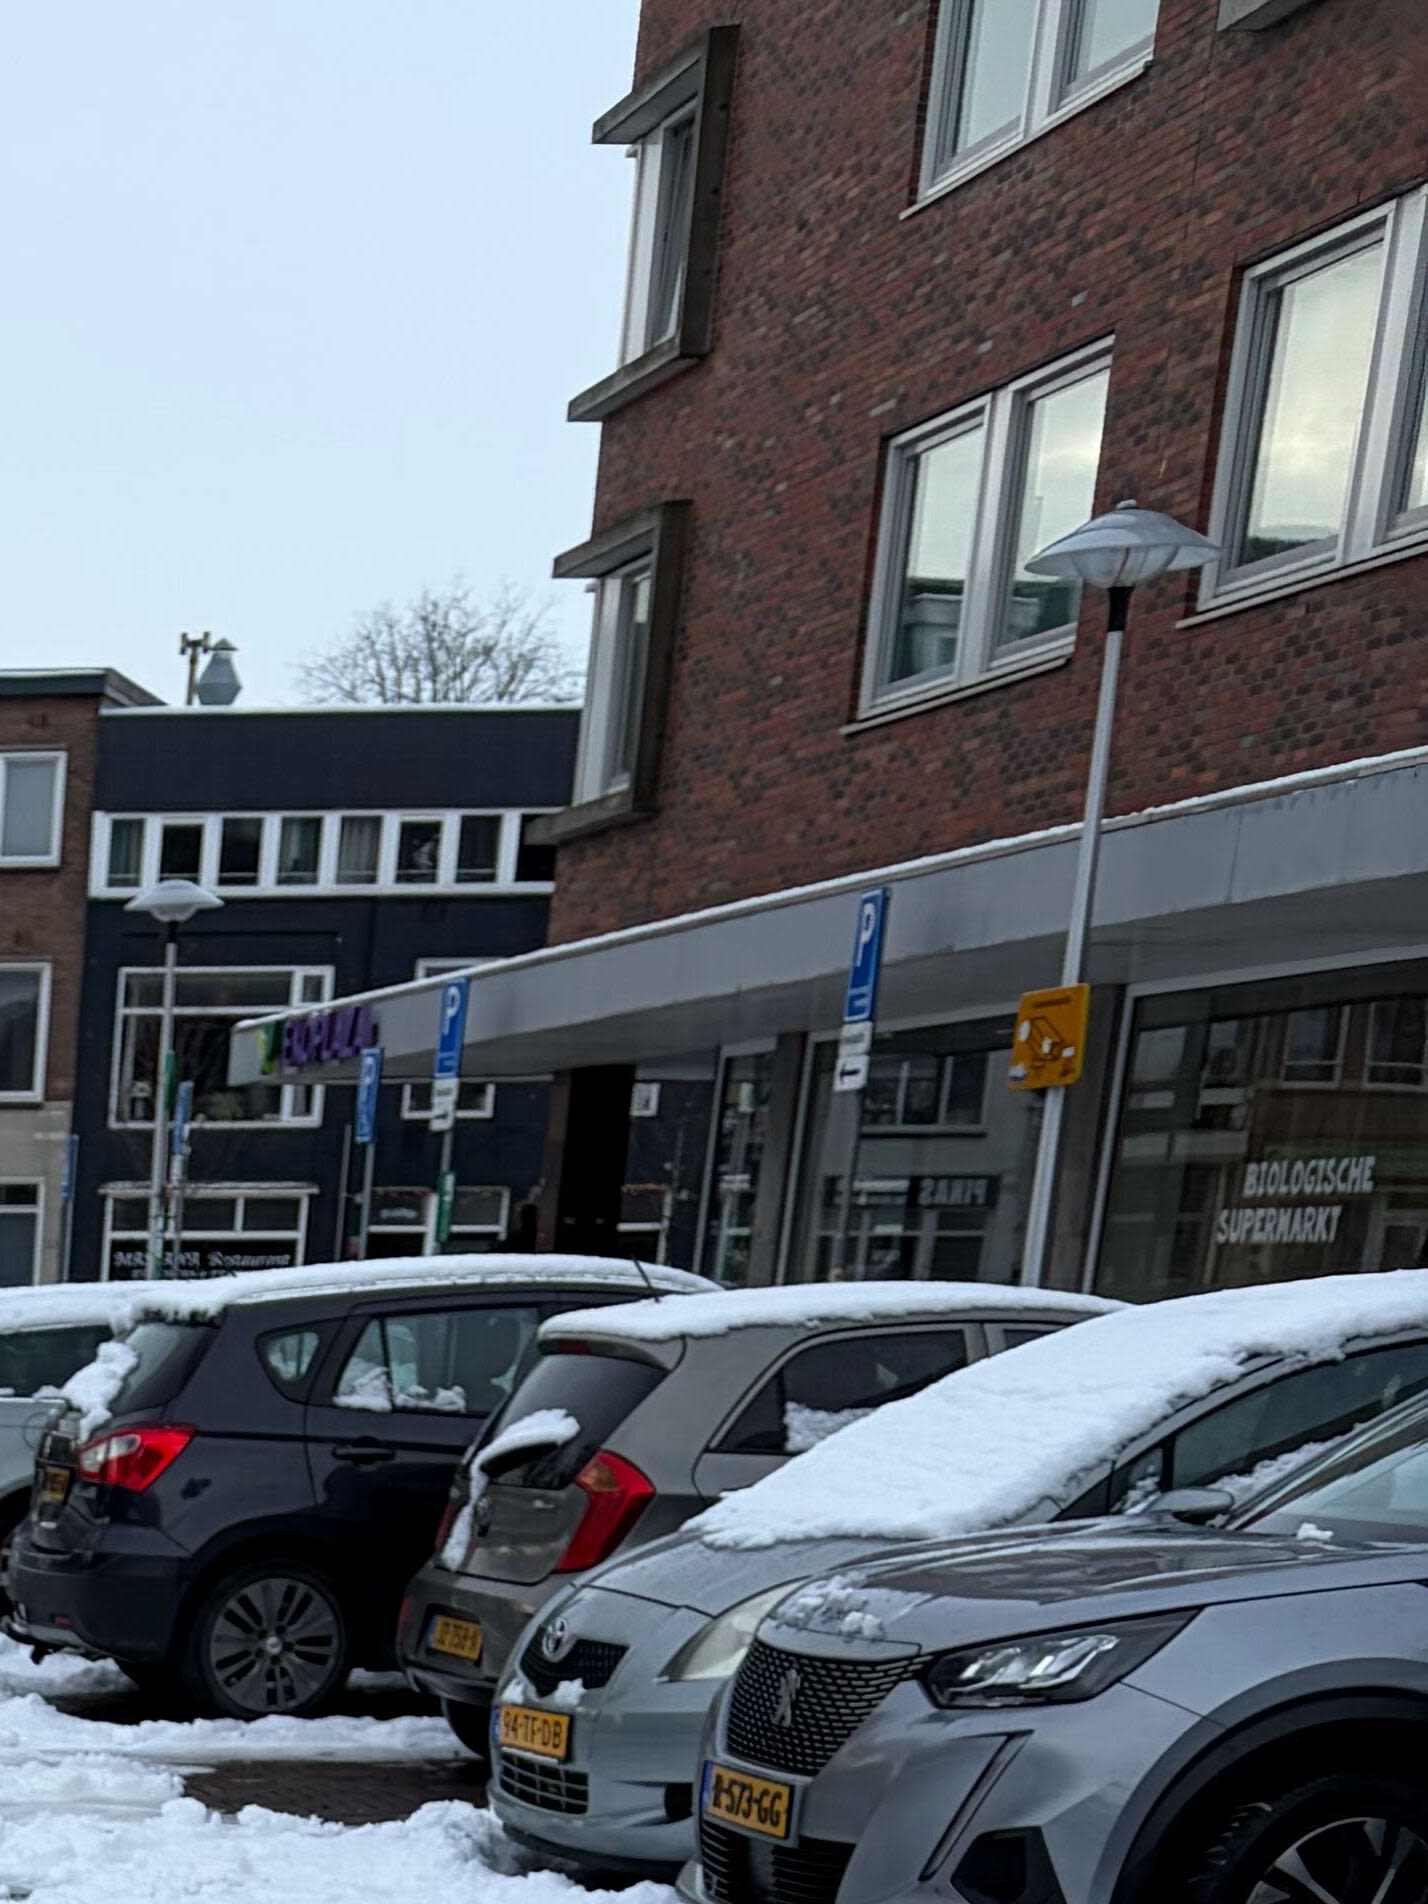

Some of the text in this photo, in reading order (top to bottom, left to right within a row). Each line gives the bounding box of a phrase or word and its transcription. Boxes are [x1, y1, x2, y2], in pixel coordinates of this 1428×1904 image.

[857, 903, 875, 967] P
[443, 986, 461, 1035] P
[1243, 1156, 1376, 1198] BIOLOGISCHE
[1216, 1206, 1342, 1244] SUPERMARKT
[503, 1711, 563, 1749] 94-TF-DB
